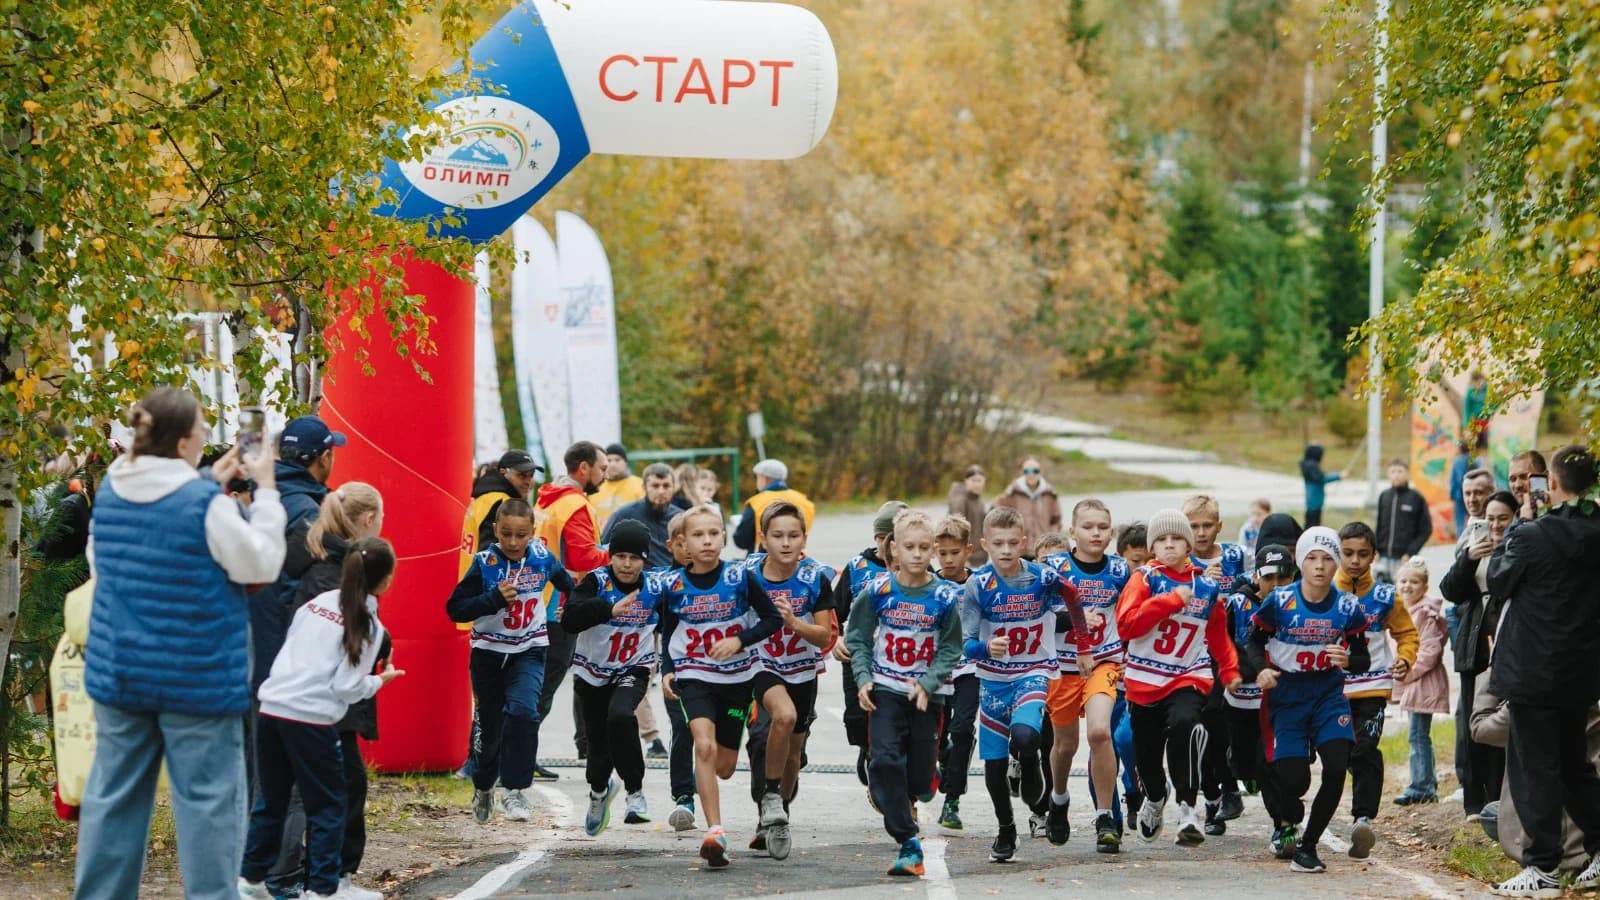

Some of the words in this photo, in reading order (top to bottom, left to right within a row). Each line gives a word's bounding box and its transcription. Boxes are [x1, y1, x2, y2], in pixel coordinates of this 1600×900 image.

[598, 54, 794, 107] СТАРТ
[424, 166, 510, 187] ОЛИМП
[307, 603, 345, 626] RUSSI
[606, 631, 640, 664] 18
[885, 632, 935, 668] 184
[1153, 619, 1199, 659] 37
